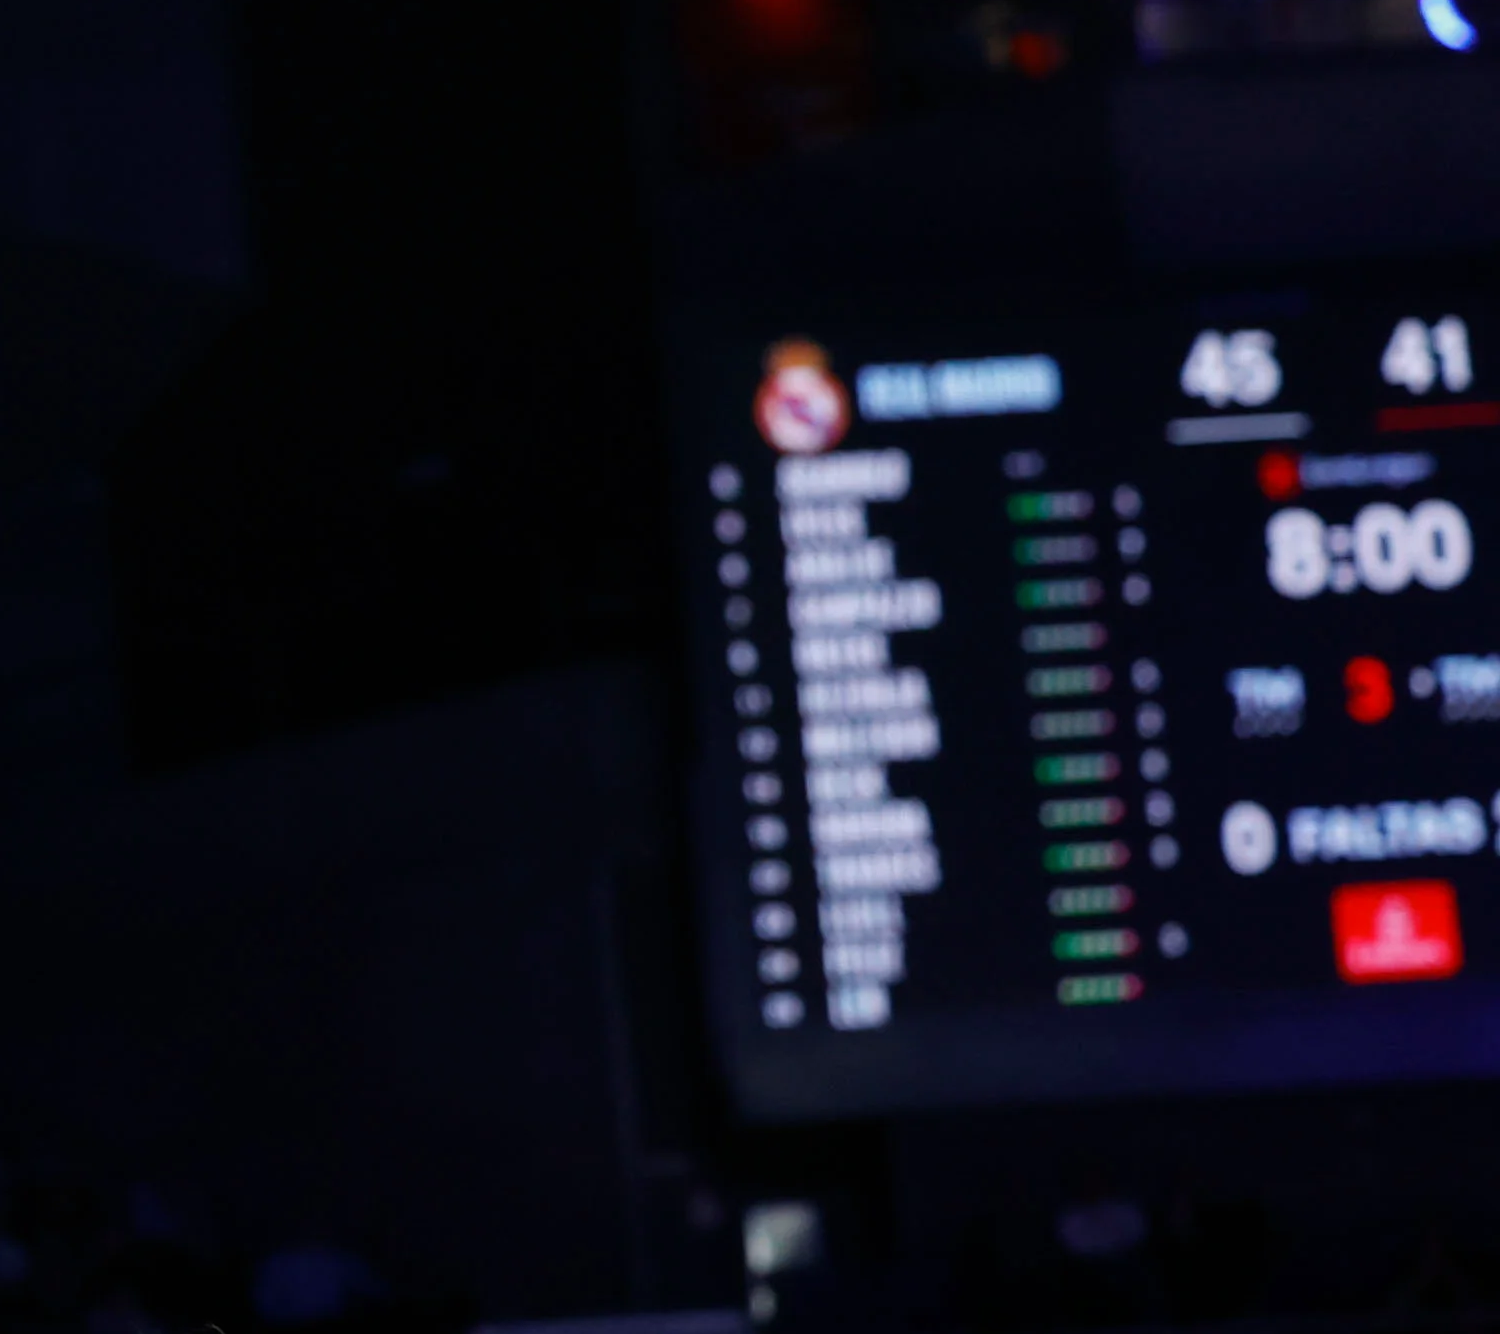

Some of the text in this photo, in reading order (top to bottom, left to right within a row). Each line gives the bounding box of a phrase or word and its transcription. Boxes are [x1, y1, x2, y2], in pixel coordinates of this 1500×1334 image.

[1179, 314, 1474, 408] 45 41
[1264, 498, 1474, 600] 8:00
[1343, 655, 1395, 725] 3
[1219, 796, 1488, 876] 0 FALTAS
